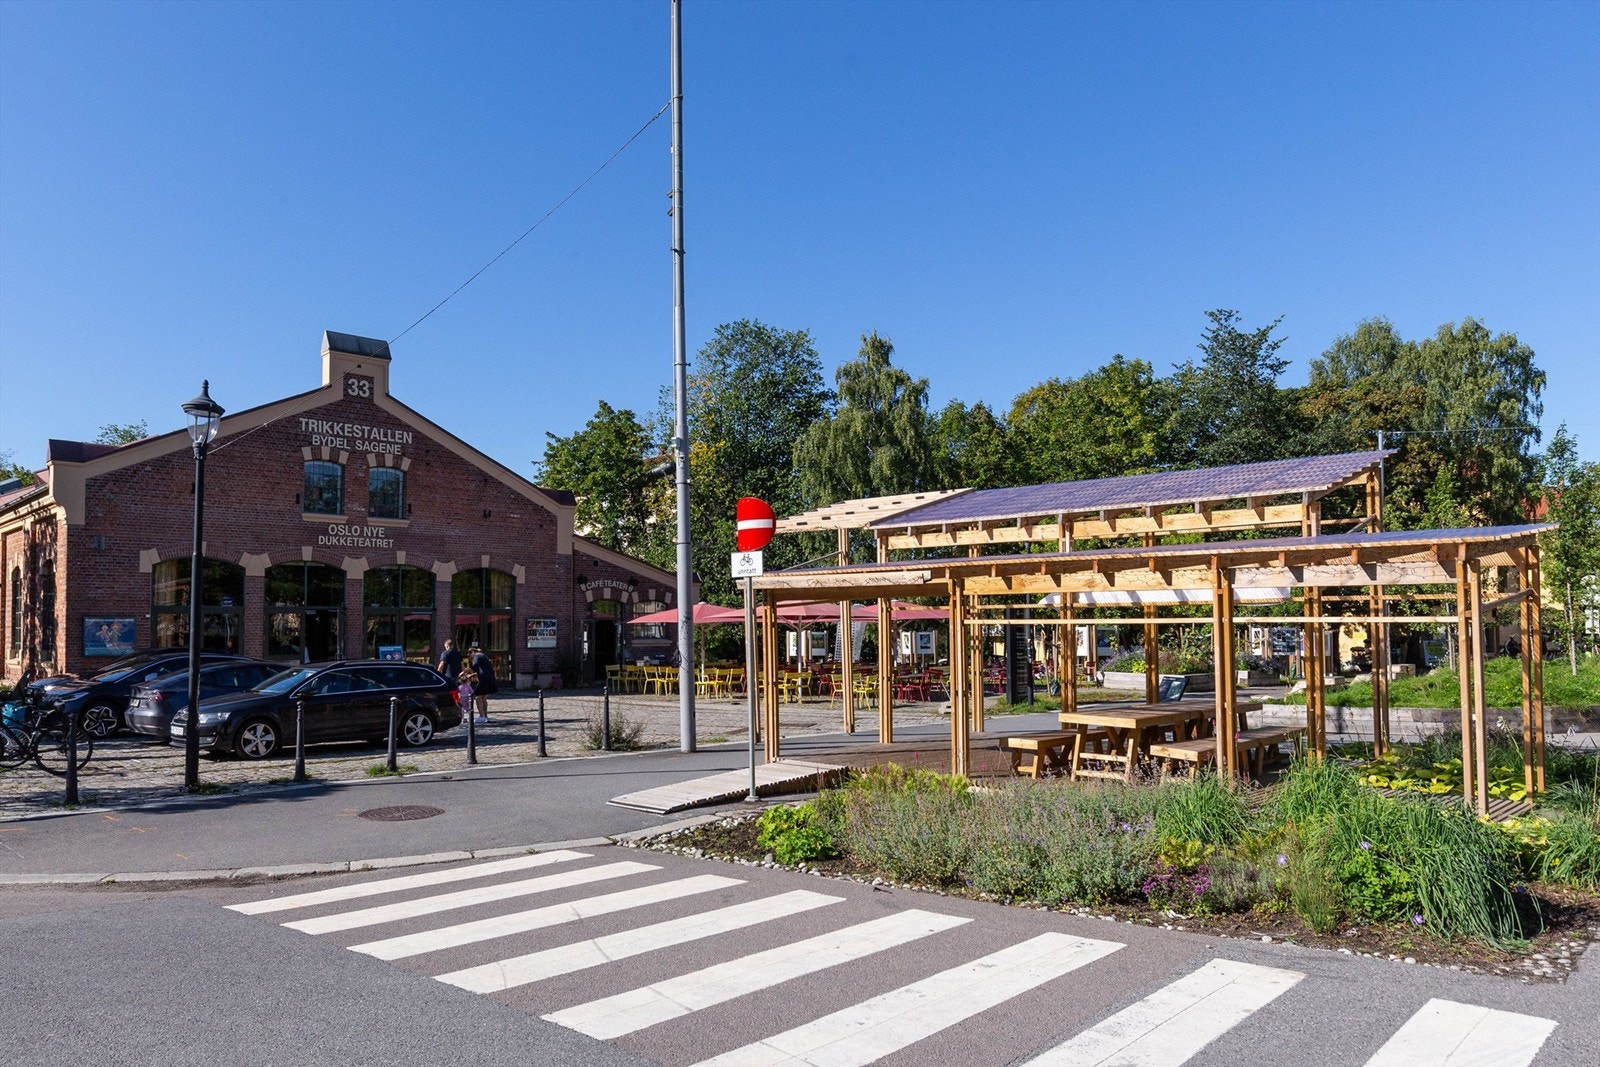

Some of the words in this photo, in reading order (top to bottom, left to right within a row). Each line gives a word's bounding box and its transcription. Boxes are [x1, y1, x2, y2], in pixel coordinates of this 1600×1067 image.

[347, 378, 370, 398] 33
[299, 418, 412, 444] TRIKKESTALLEN
[311, 434, 351, 450] BYDEL
[355, 440, 402, 455] SAGENE
[328, 524, 360, 536] OSLO
[363, 526, 386, 538] NYE
[318, 535, 394, 548] DUKKETEATRET
[604, 579, 629, 590] TEATER
